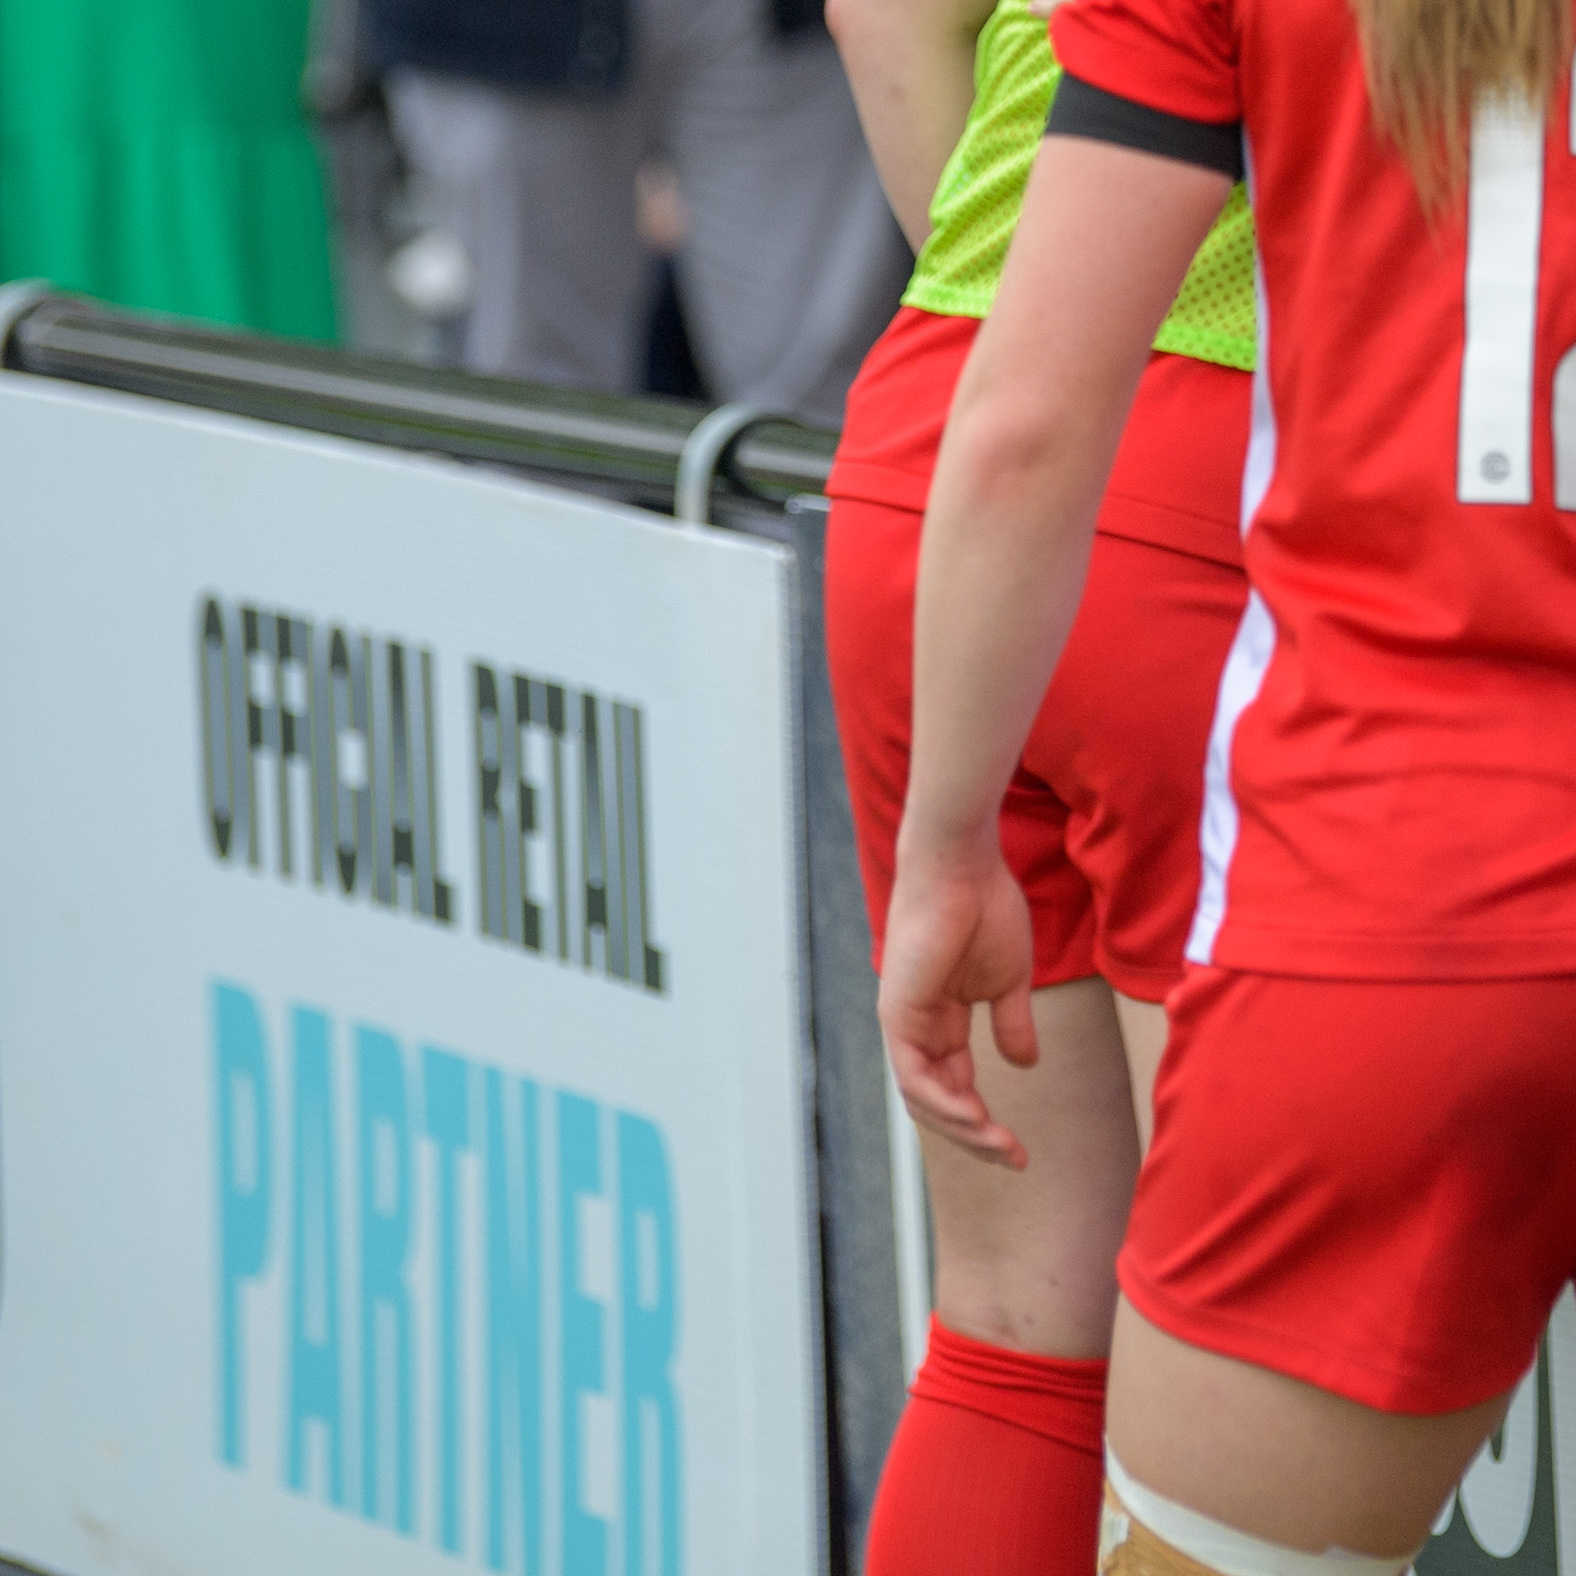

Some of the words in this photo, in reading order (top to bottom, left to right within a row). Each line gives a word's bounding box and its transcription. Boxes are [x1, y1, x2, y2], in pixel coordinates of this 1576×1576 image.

[198, 592, 460, 926] OFFICIAL
[470, 658, 668, 996] RETAIL
[208, 974, 686, 1576] PARTNER
